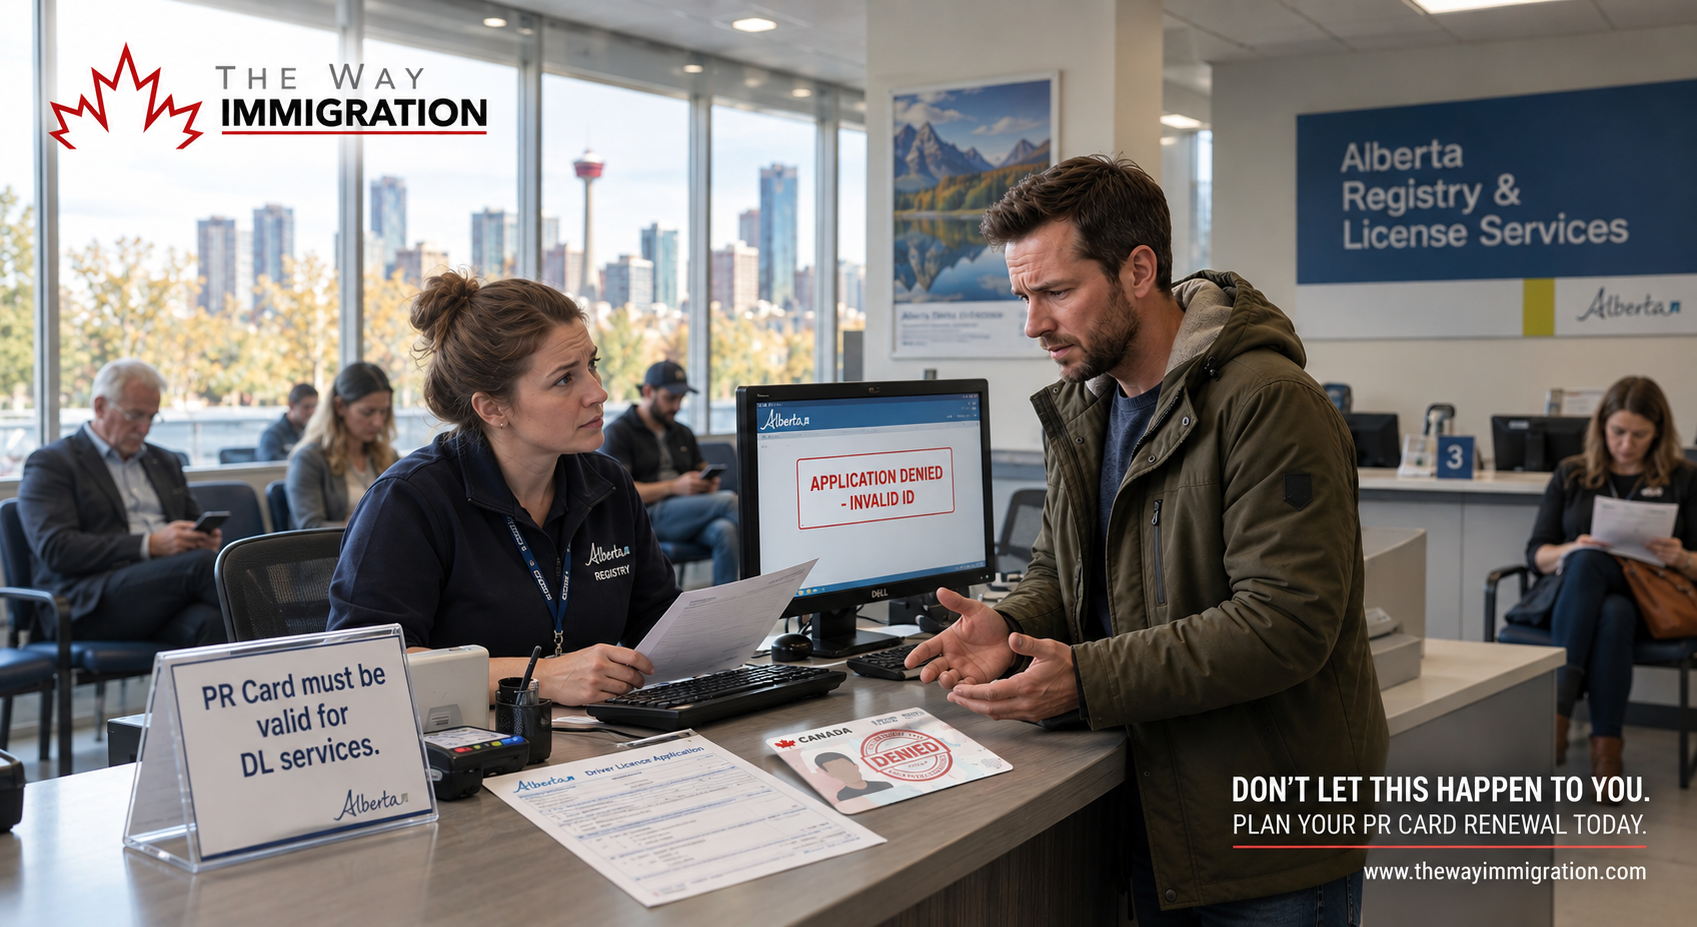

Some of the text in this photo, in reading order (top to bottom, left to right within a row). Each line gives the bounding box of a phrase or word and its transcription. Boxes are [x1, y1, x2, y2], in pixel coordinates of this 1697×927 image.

[1341, 139, 1463, 173] Alberta
[1343, 173, 1521, 217] Registry &
[1343, 212, 1630, 250] License Services
[1576, 287, 1676, 322] Alberta
[760, 408, 806, 430] Alberta
[1446, 444, 1463, 470] 3
[810, 465, 943, 492] APPLICATION DENIED
[850, 492, 899, 511] INVALID
[902, 490, 915, 505] ID
[585, 542, 626, 566] Alberta
[594, 564, 630, 581] REGISTRY
[871, 588, 889, 598] DELL
[202, 663, 386, 710] PR Card must be
[256, 703, 349, 738] valid for
[798, 726, 853, 744] CANADA
[240, 737, 380, 778] DL services.
[585, 766, 615, 777] Driver
[653, 745, 705, 763] Application
[870, 741, 940, 768] DENIED
[513, 775, 569, 794] Alberta
[333, 789, 402, 821] Alberta
